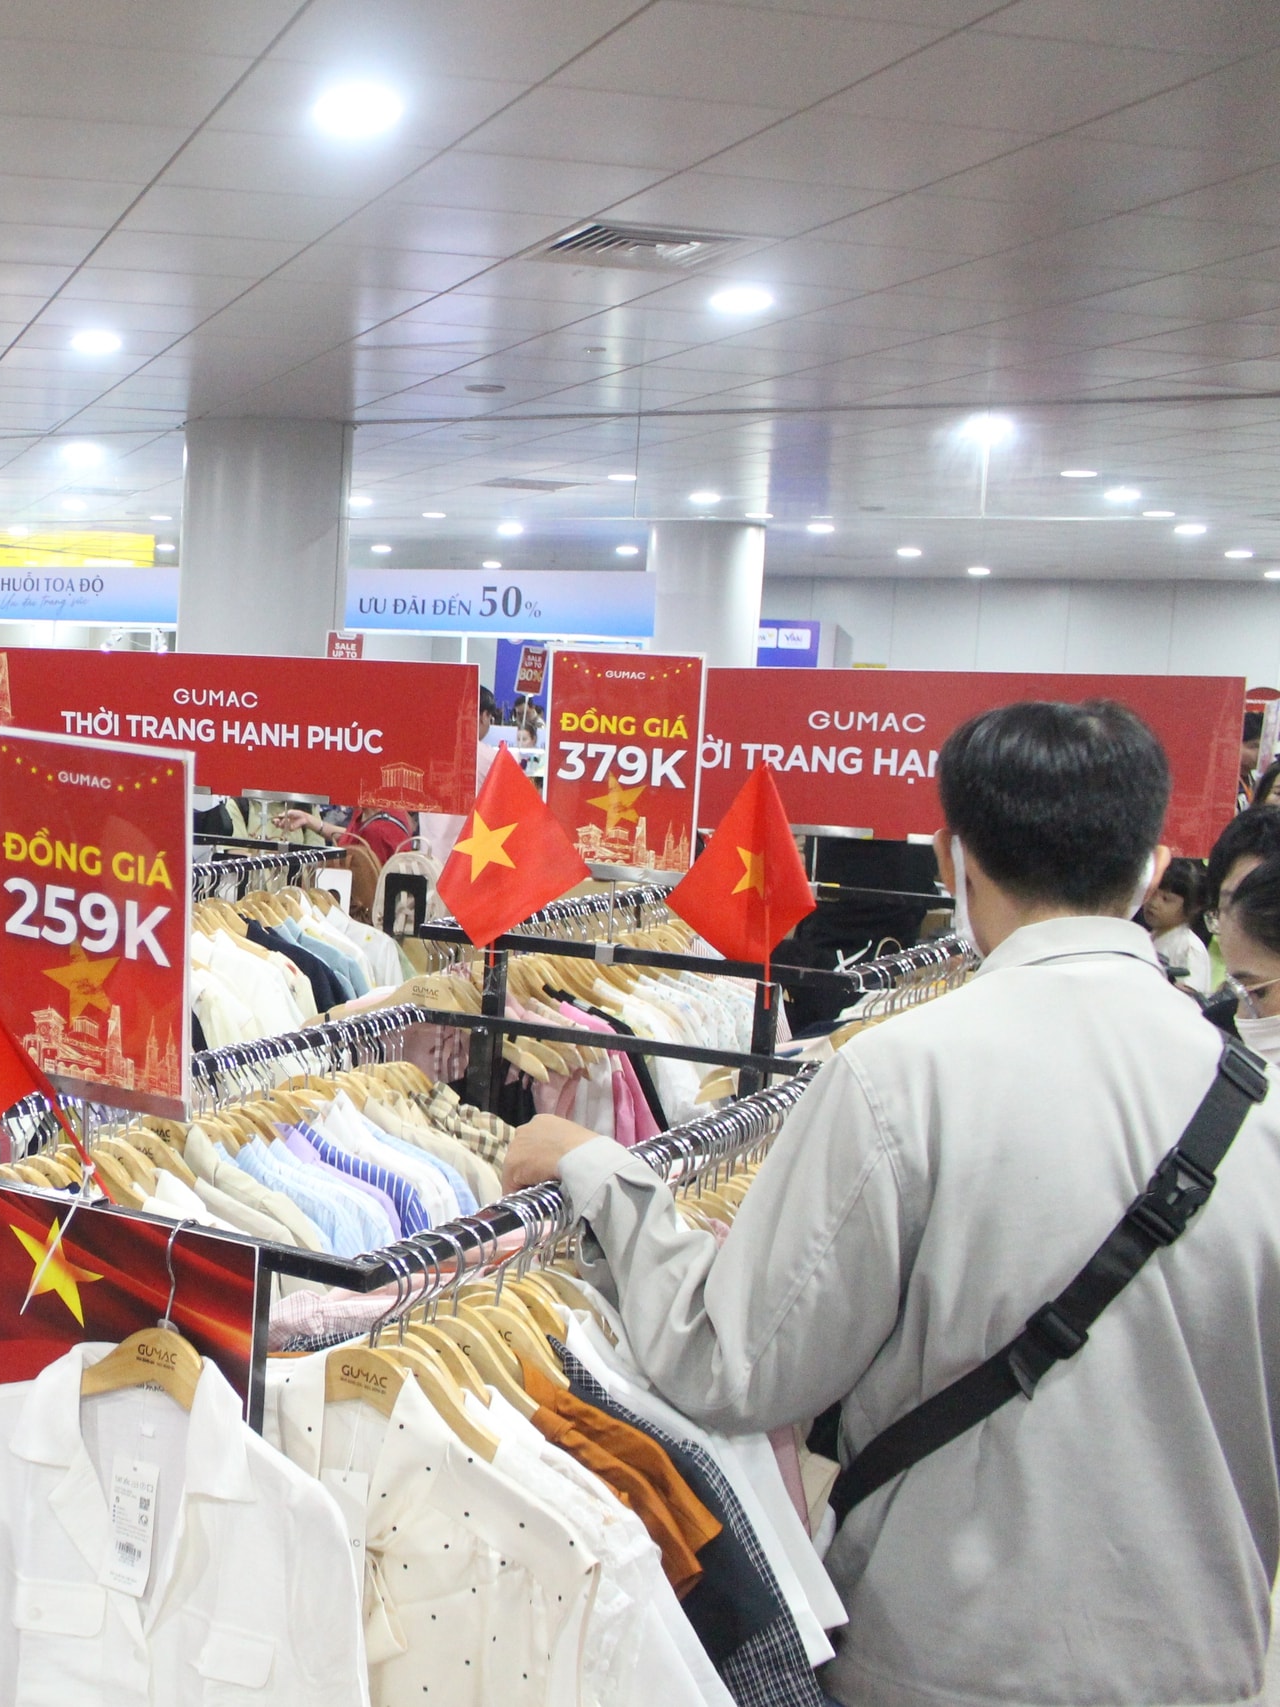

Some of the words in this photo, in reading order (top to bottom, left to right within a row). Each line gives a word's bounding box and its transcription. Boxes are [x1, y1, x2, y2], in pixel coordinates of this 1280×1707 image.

[79, 574, 104, 596] ĐỘ
[359, 597, 387, 614] ƯU
[392, 595, 426, 615] ĐÃI
[432, 593, 472, 616] ĐẾN
[334, 642, 357, 650] SALE
[605, 669, 646, 681] GUMAC
[173, 687, 258, 708] GUMAC
[61, 706, 119, 736] THỜI
[126, 714, 215, 743] TRANG
[222, 721, 299, 751] HẠNH
[307, 721, 384, 754] PHÚC
[560, 707, 636, 736] ĐỒNG
[643, 714, 688, 740] GIÁ
[808, 710, 926, 733] GUMAC
[557, 741, 687, 789] 379K
[741, 743, 863, 774] TRANG
[57, 770, 112, 790] GUMAC
[2, 827, 102, 877] ĐỒNG
[111, 850, 173, 890] GIÁ
[3, 876, 172, 968] 259K
[137, 1343, 178, 1365] GUMAC
[341, 1364, 388, 1389] GUMAC
